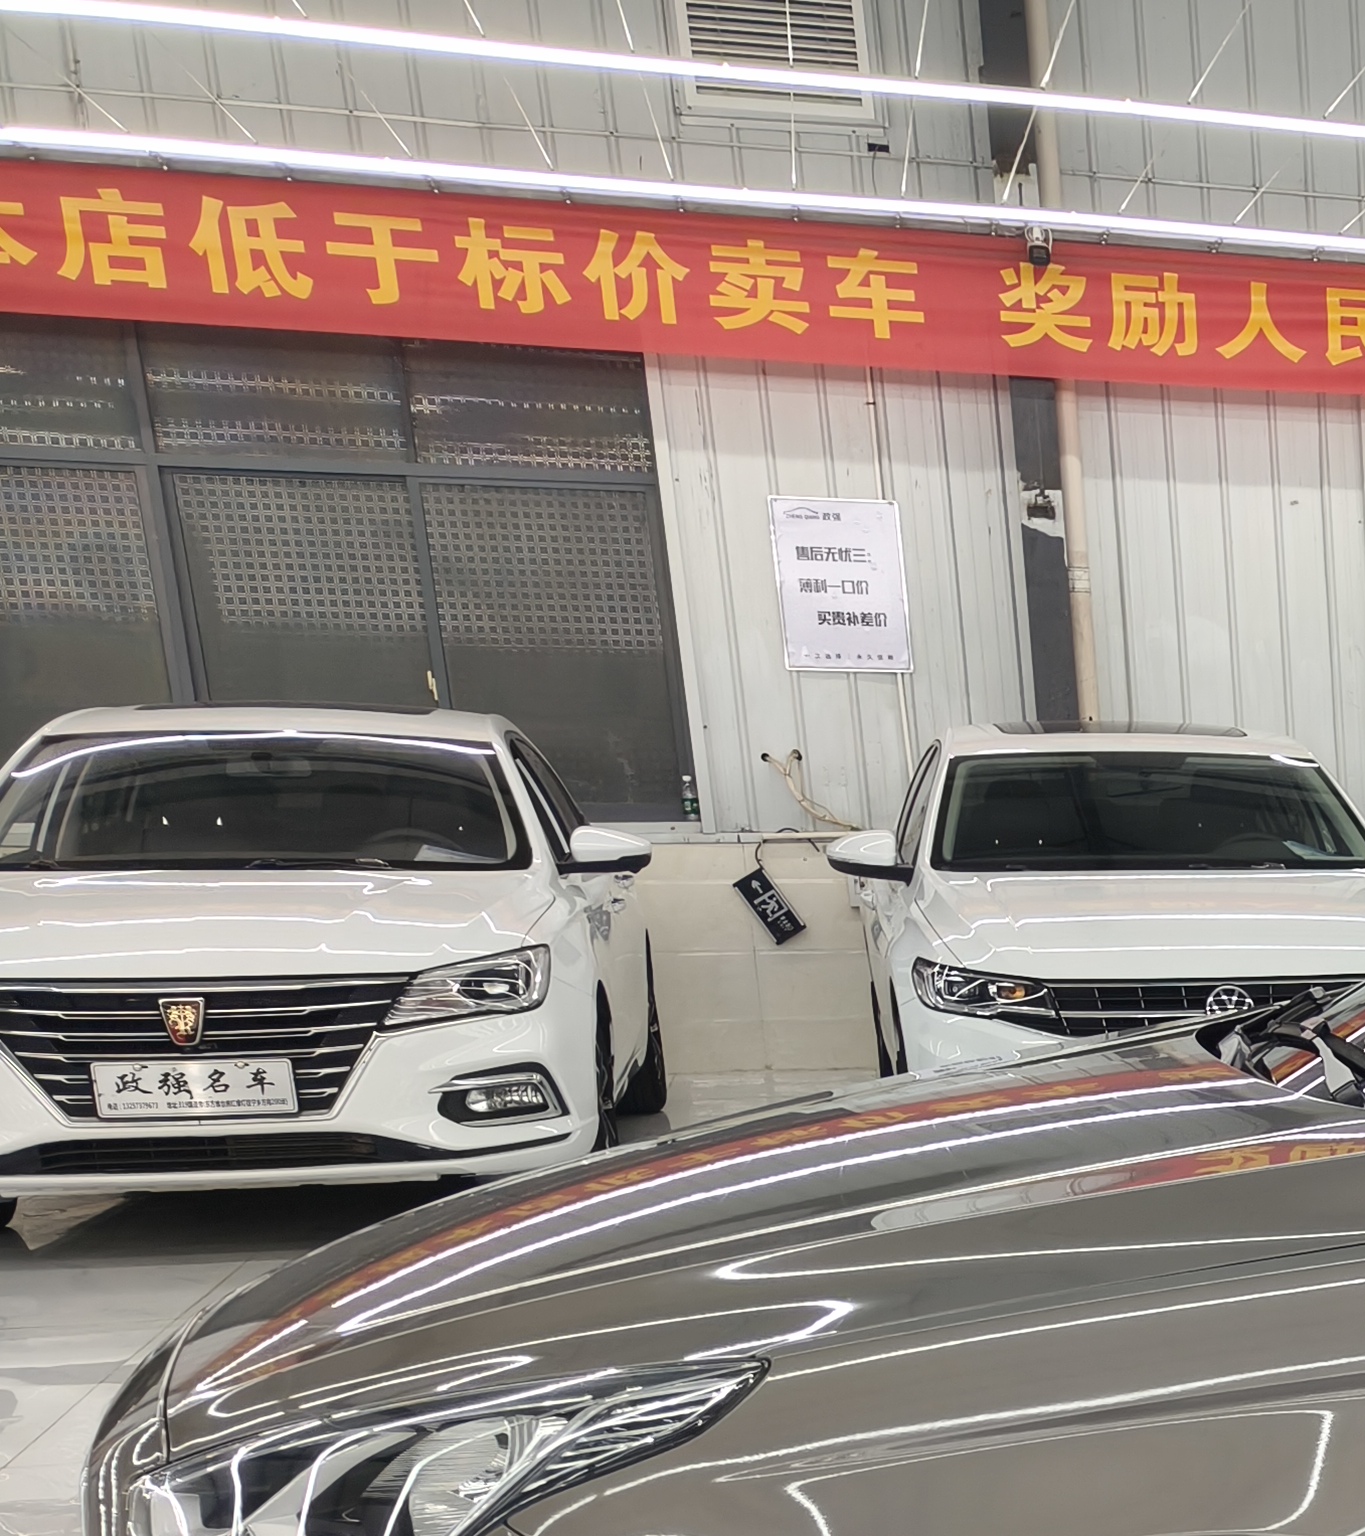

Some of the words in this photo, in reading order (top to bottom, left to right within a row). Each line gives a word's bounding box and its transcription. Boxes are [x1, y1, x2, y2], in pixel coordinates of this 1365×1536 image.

[798, 578, 869, 595] 薄利一口价
[817, 610, 888, 628] 买贵补差价
[115, 1067, 276, 1100] 政强名车
